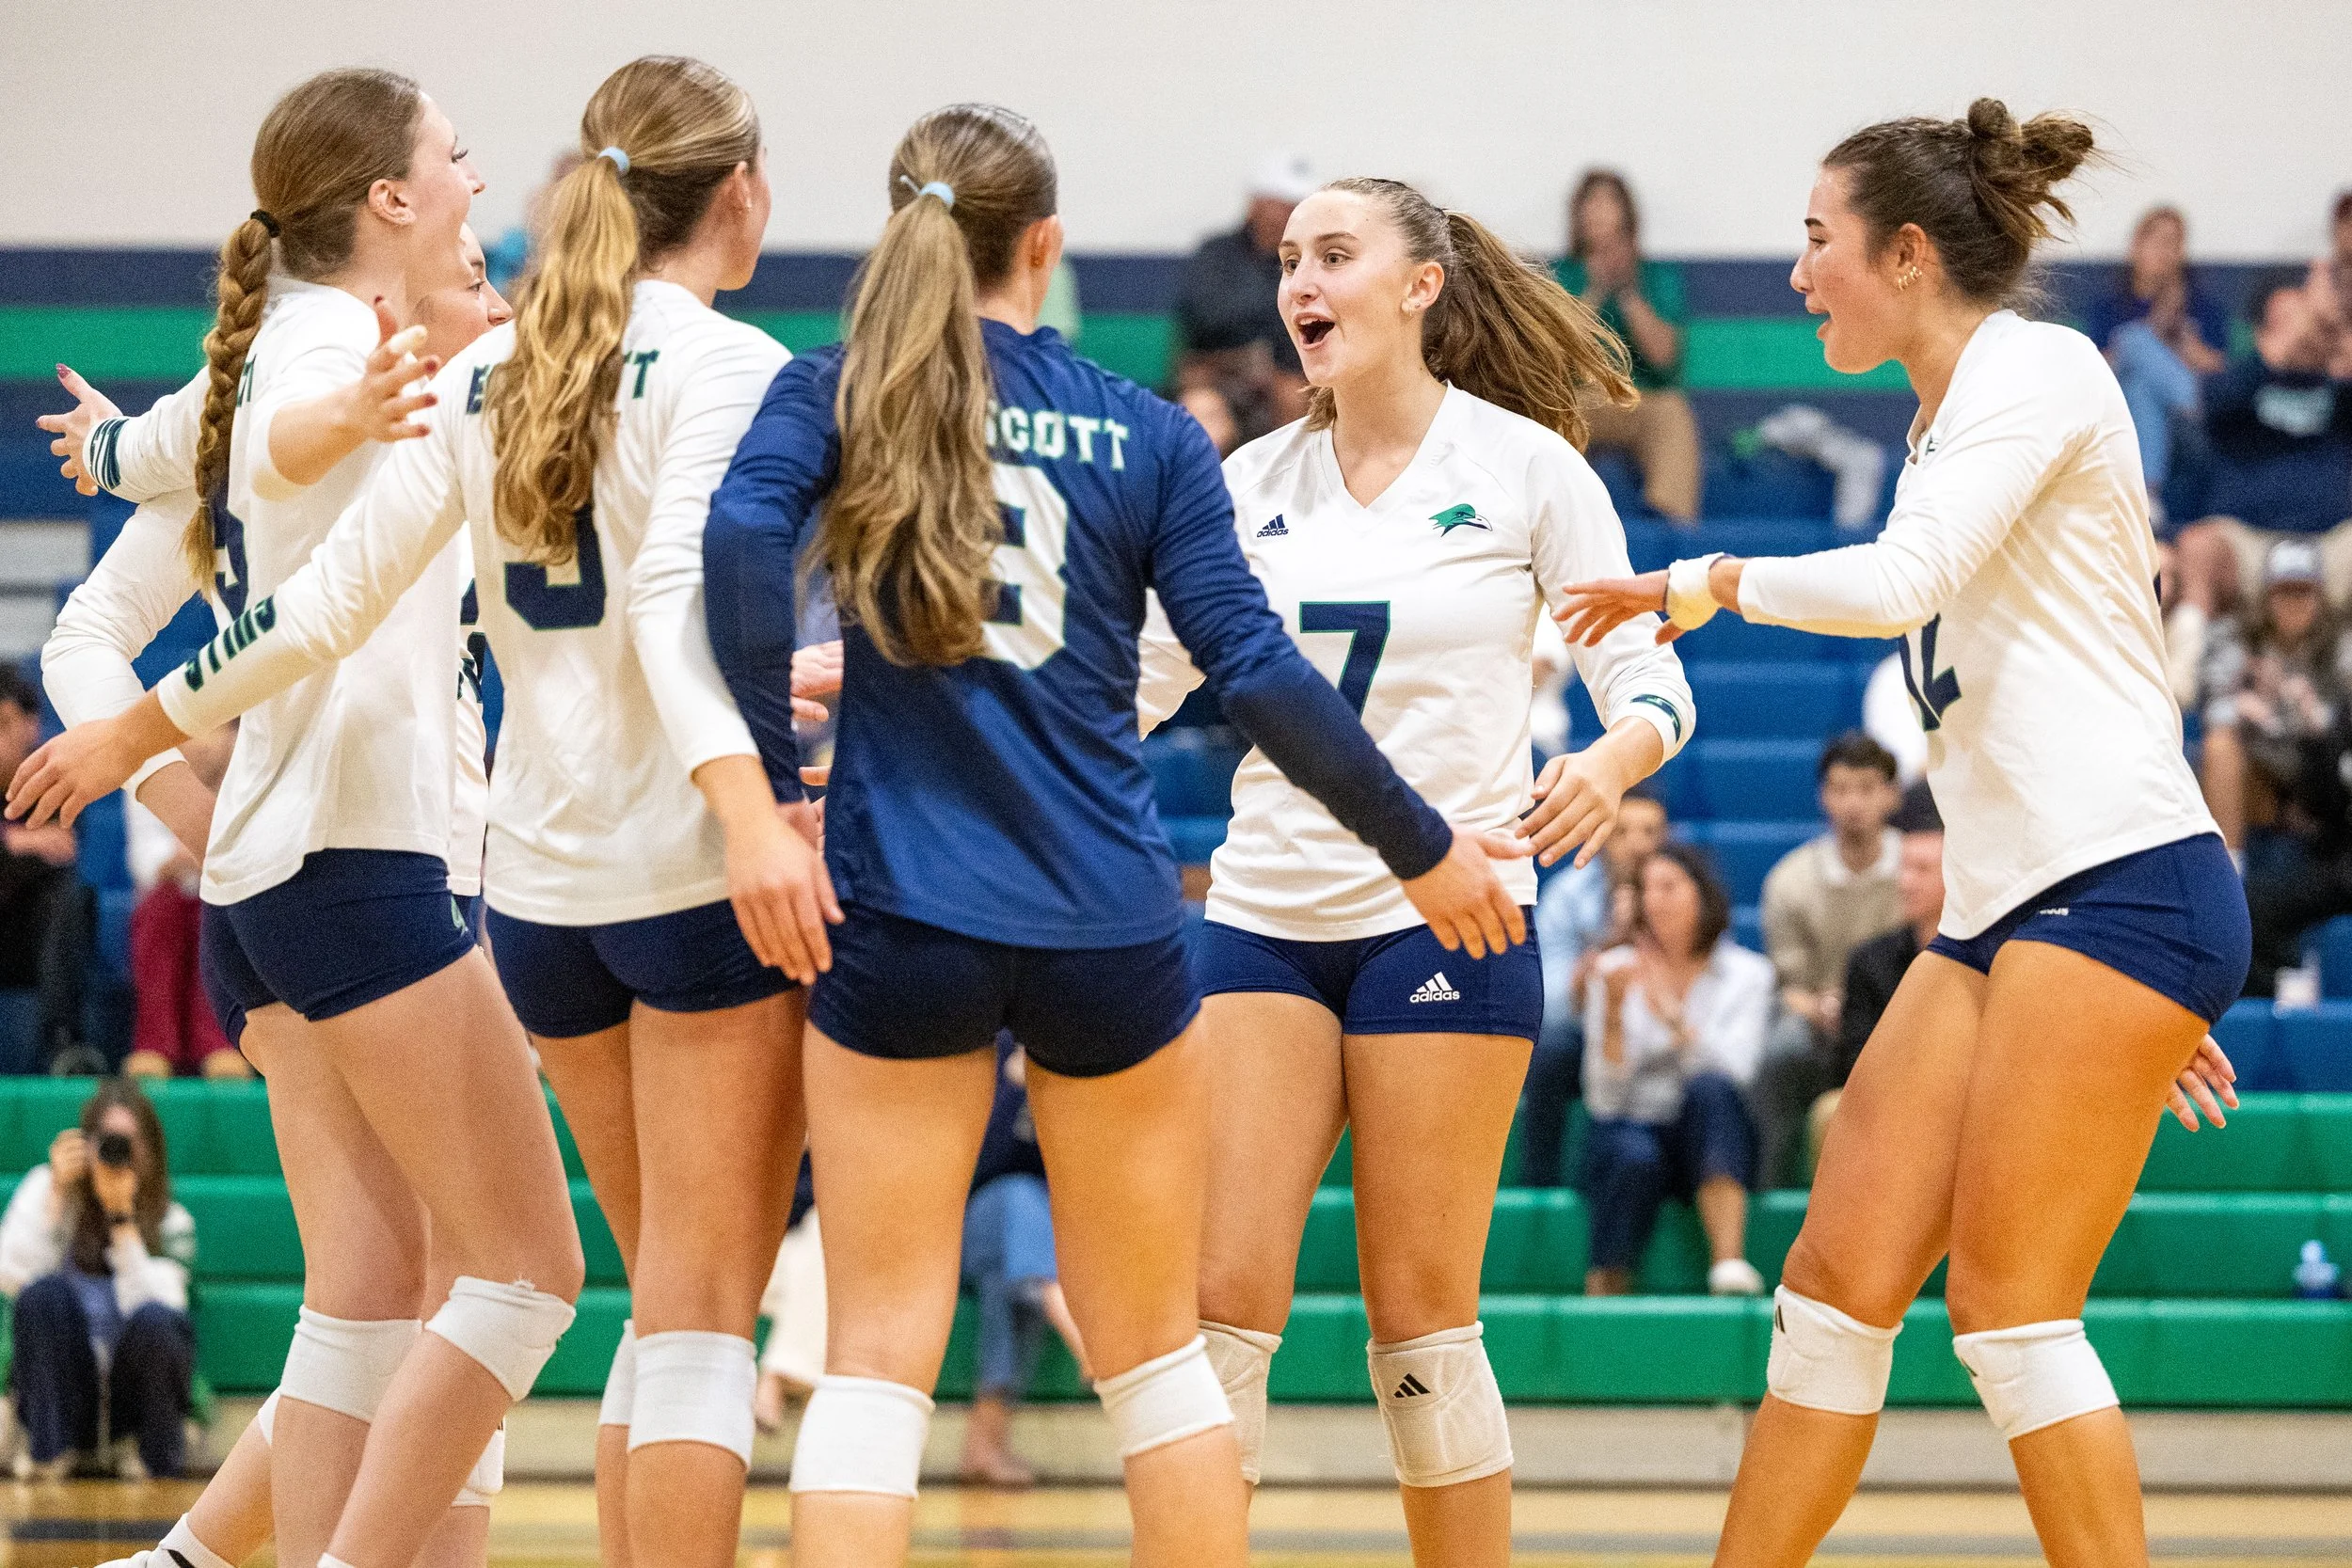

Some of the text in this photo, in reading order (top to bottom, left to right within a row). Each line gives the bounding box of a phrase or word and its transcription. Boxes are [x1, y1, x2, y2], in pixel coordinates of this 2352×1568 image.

[1256, 528, 1289, 538] adidas
[1299, 600, 1391, 722] 7
[1409, 990, 1460, 1004] adidas
